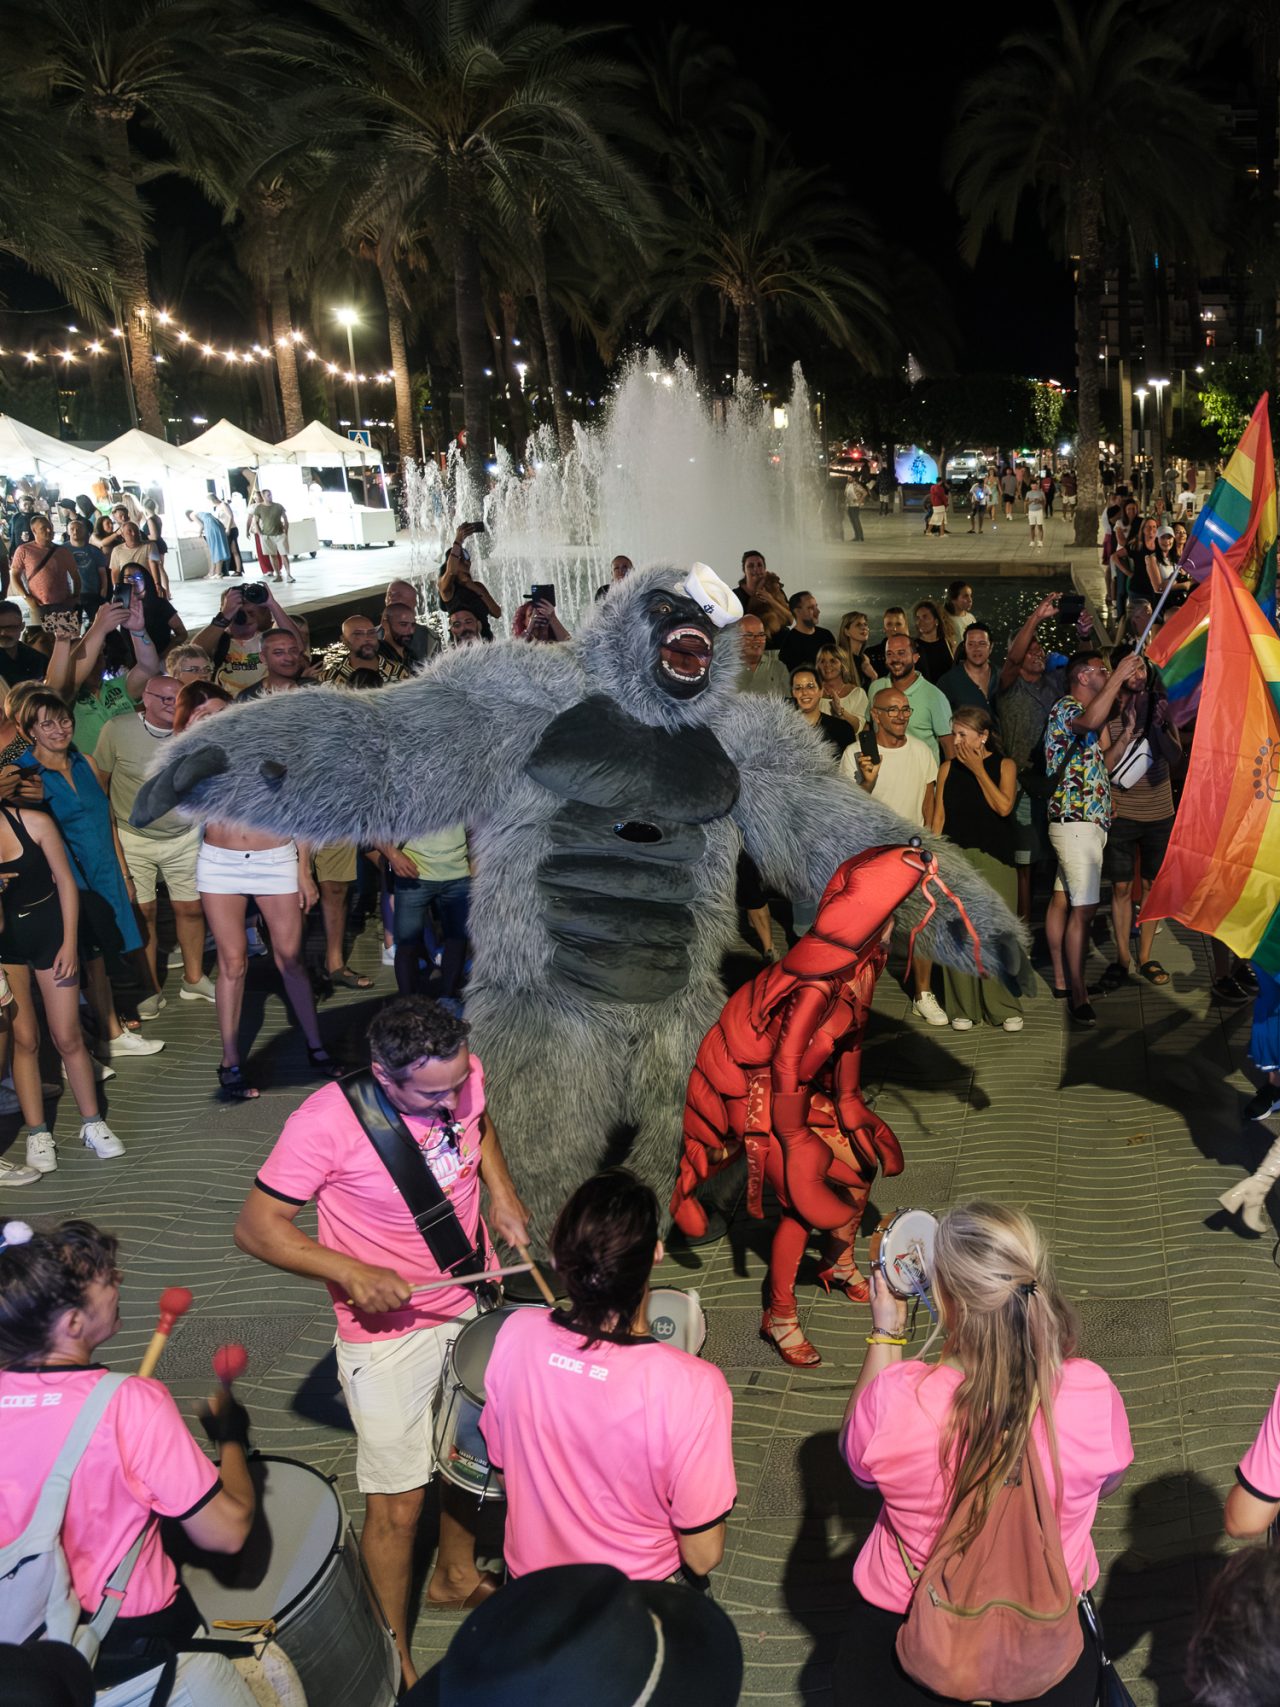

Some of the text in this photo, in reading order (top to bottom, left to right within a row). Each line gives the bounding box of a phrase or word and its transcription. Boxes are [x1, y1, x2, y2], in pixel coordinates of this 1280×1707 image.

[548, 1352, 609, 1382] CODE 22
[0, 1392, 63, 1408] CODE 22
